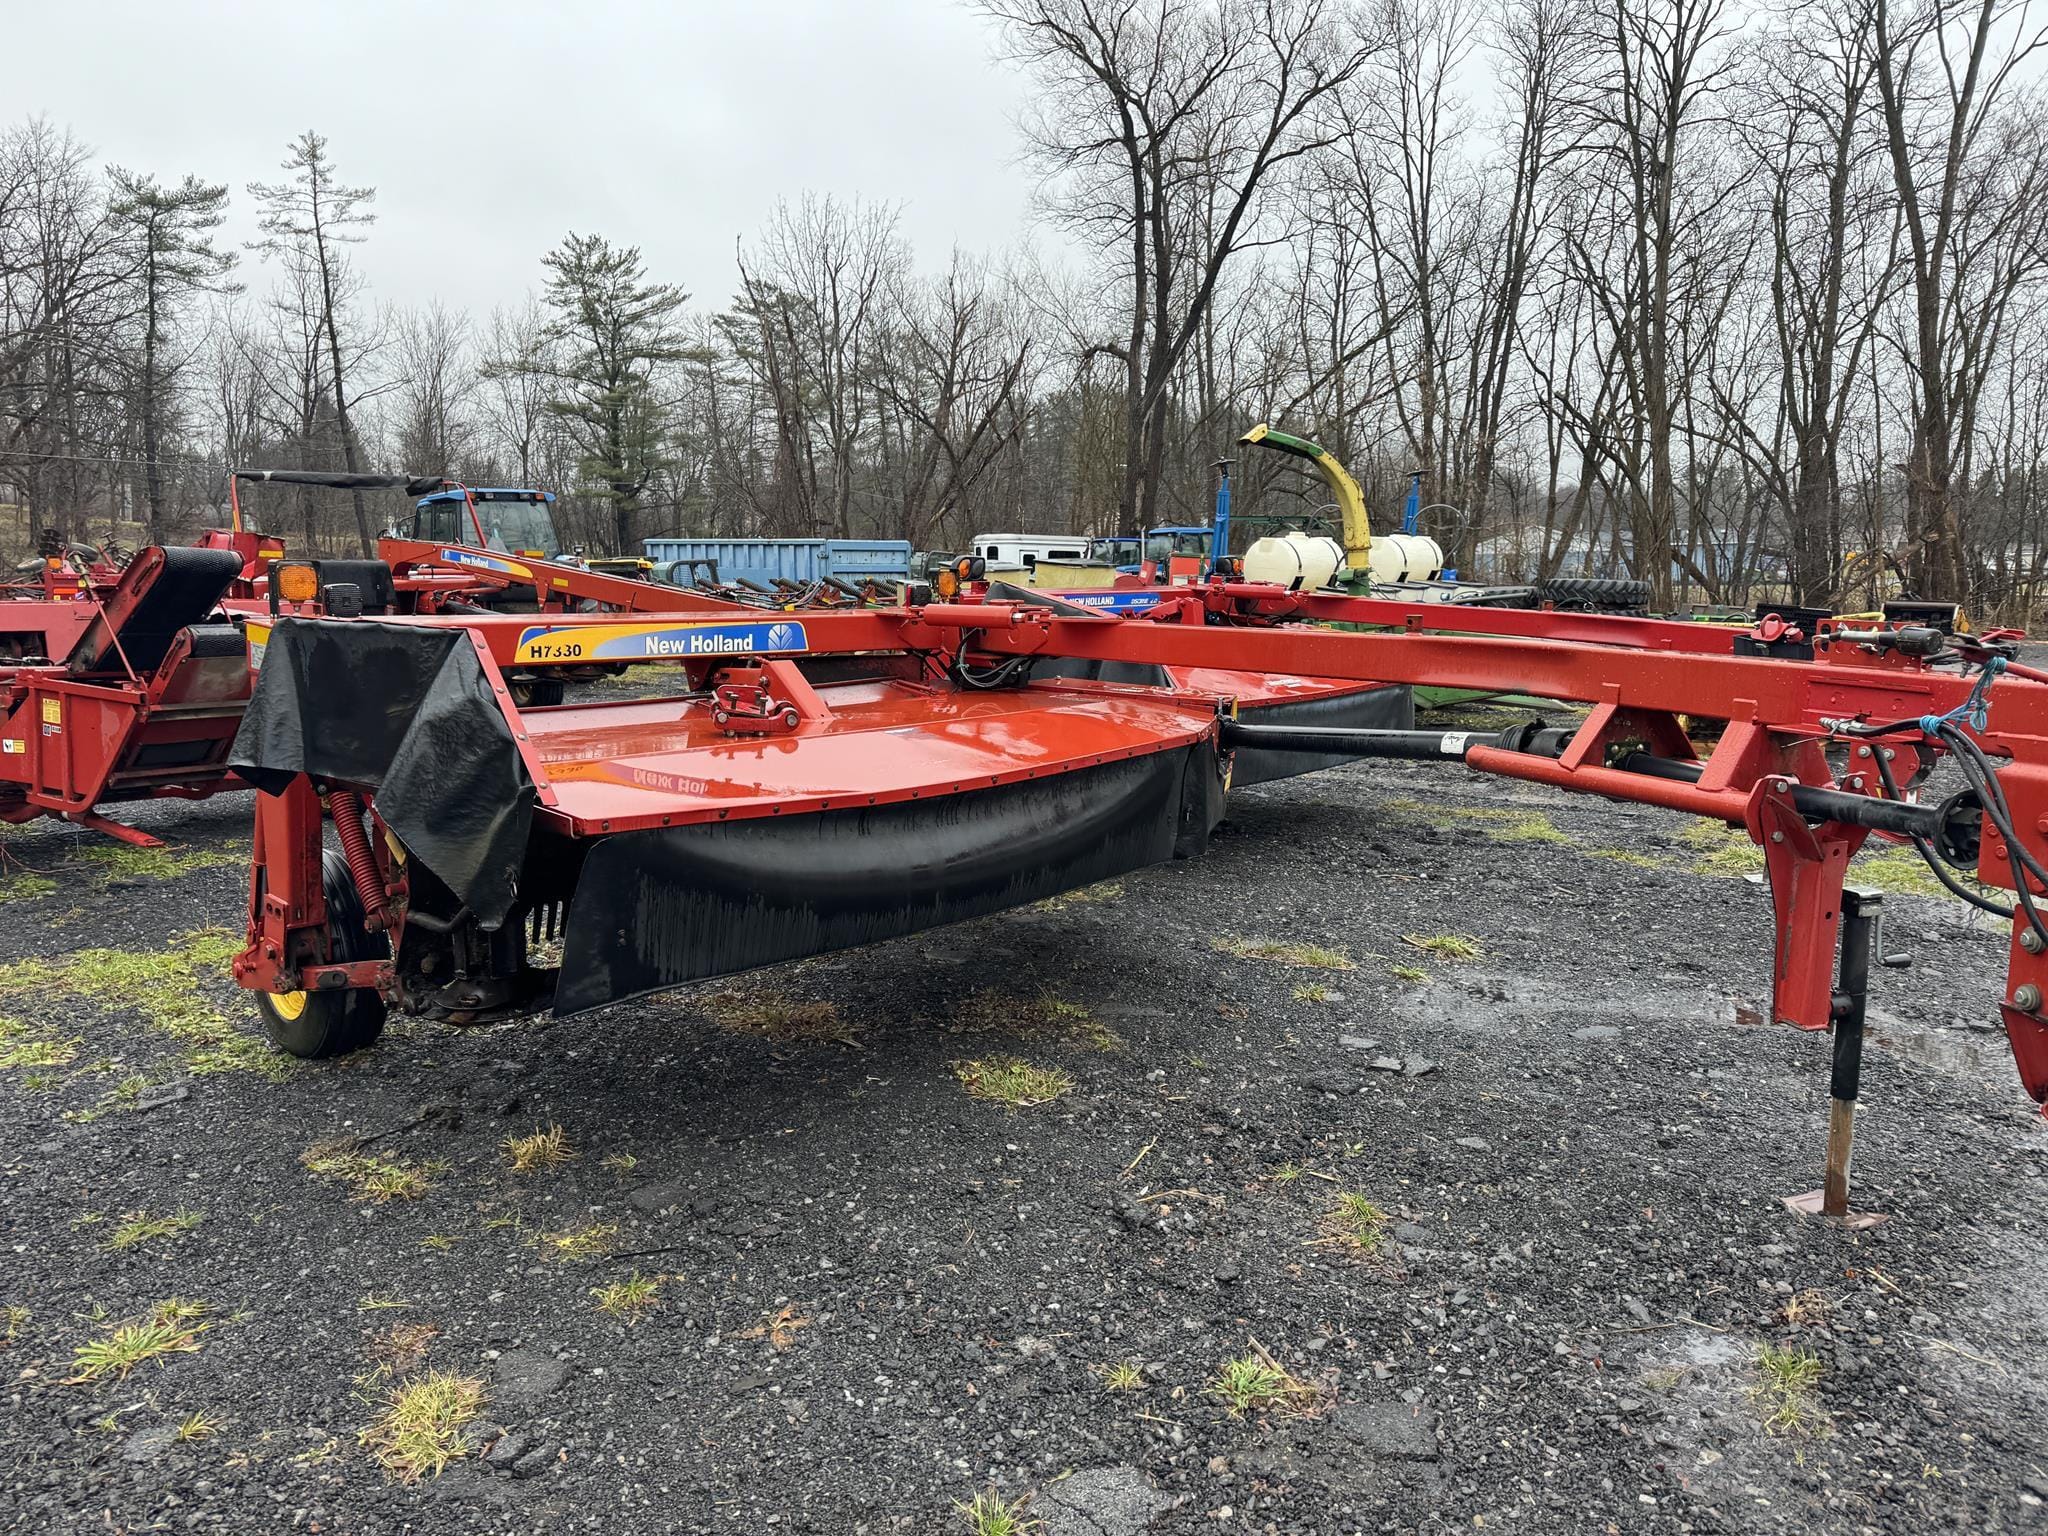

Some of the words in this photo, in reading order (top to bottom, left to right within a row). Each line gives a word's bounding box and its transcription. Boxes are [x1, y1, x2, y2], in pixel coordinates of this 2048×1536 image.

[460, 554, 471, 565] New
[471, 556, 488, 568] Holland
[1085, 596, 1115, 606] HOLLAND
[530, 644, 582, 658] H7330
[645, 636, 685, 654] New
[690, 634, 753, 653] Holland
